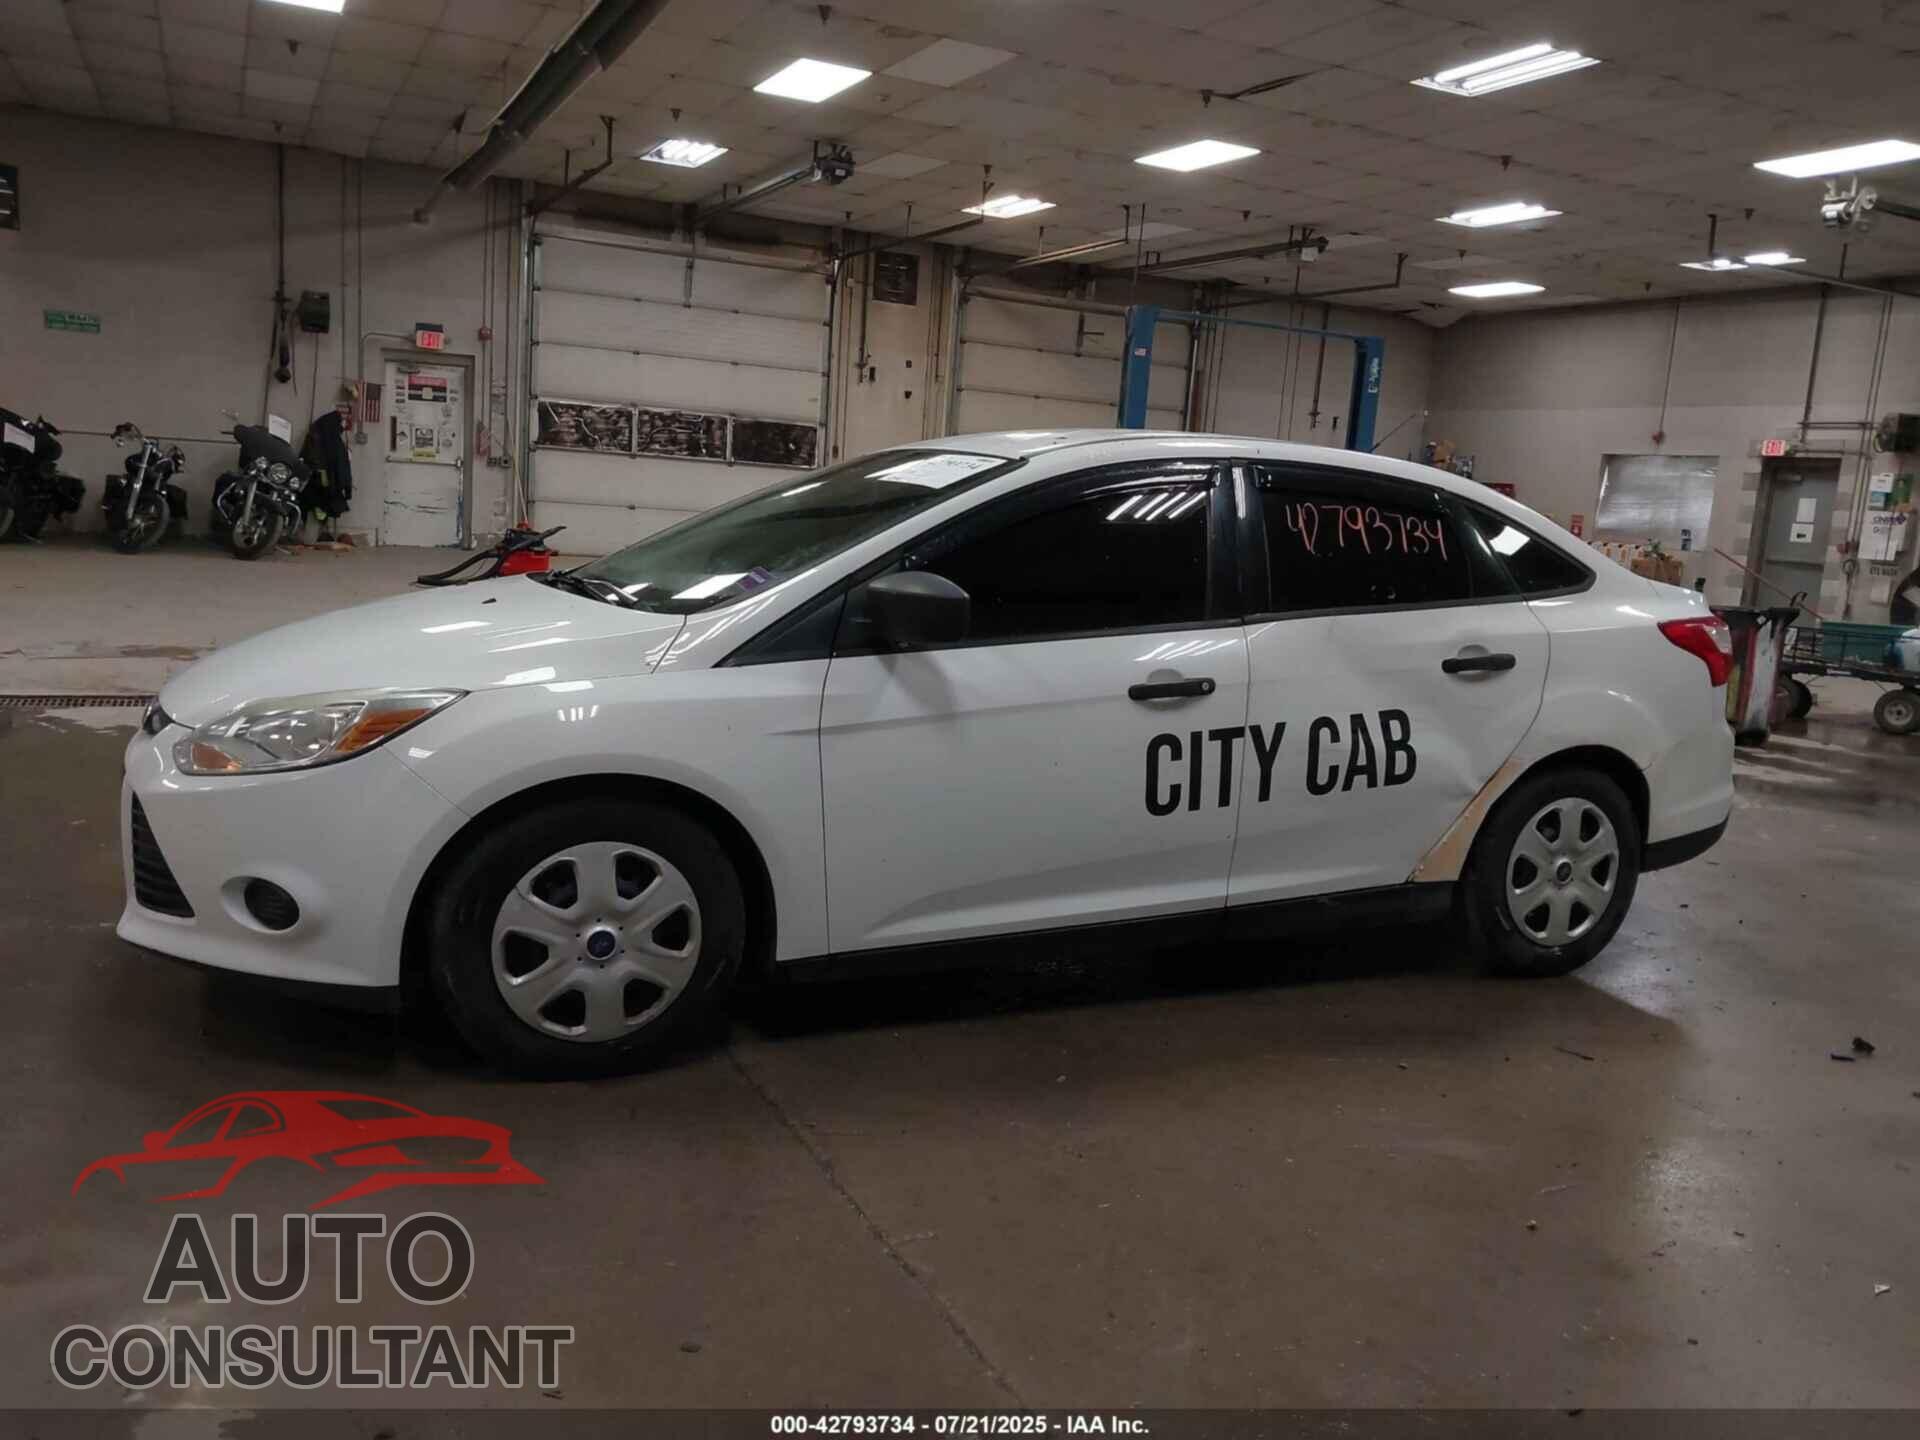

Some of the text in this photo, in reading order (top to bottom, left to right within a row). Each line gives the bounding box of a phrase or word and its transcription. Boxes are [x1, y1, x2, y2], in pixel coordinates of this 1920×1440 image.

[1286, 502, 1448, 561] 42793734
[1145, 708, 1417, 817] CITY CAB
